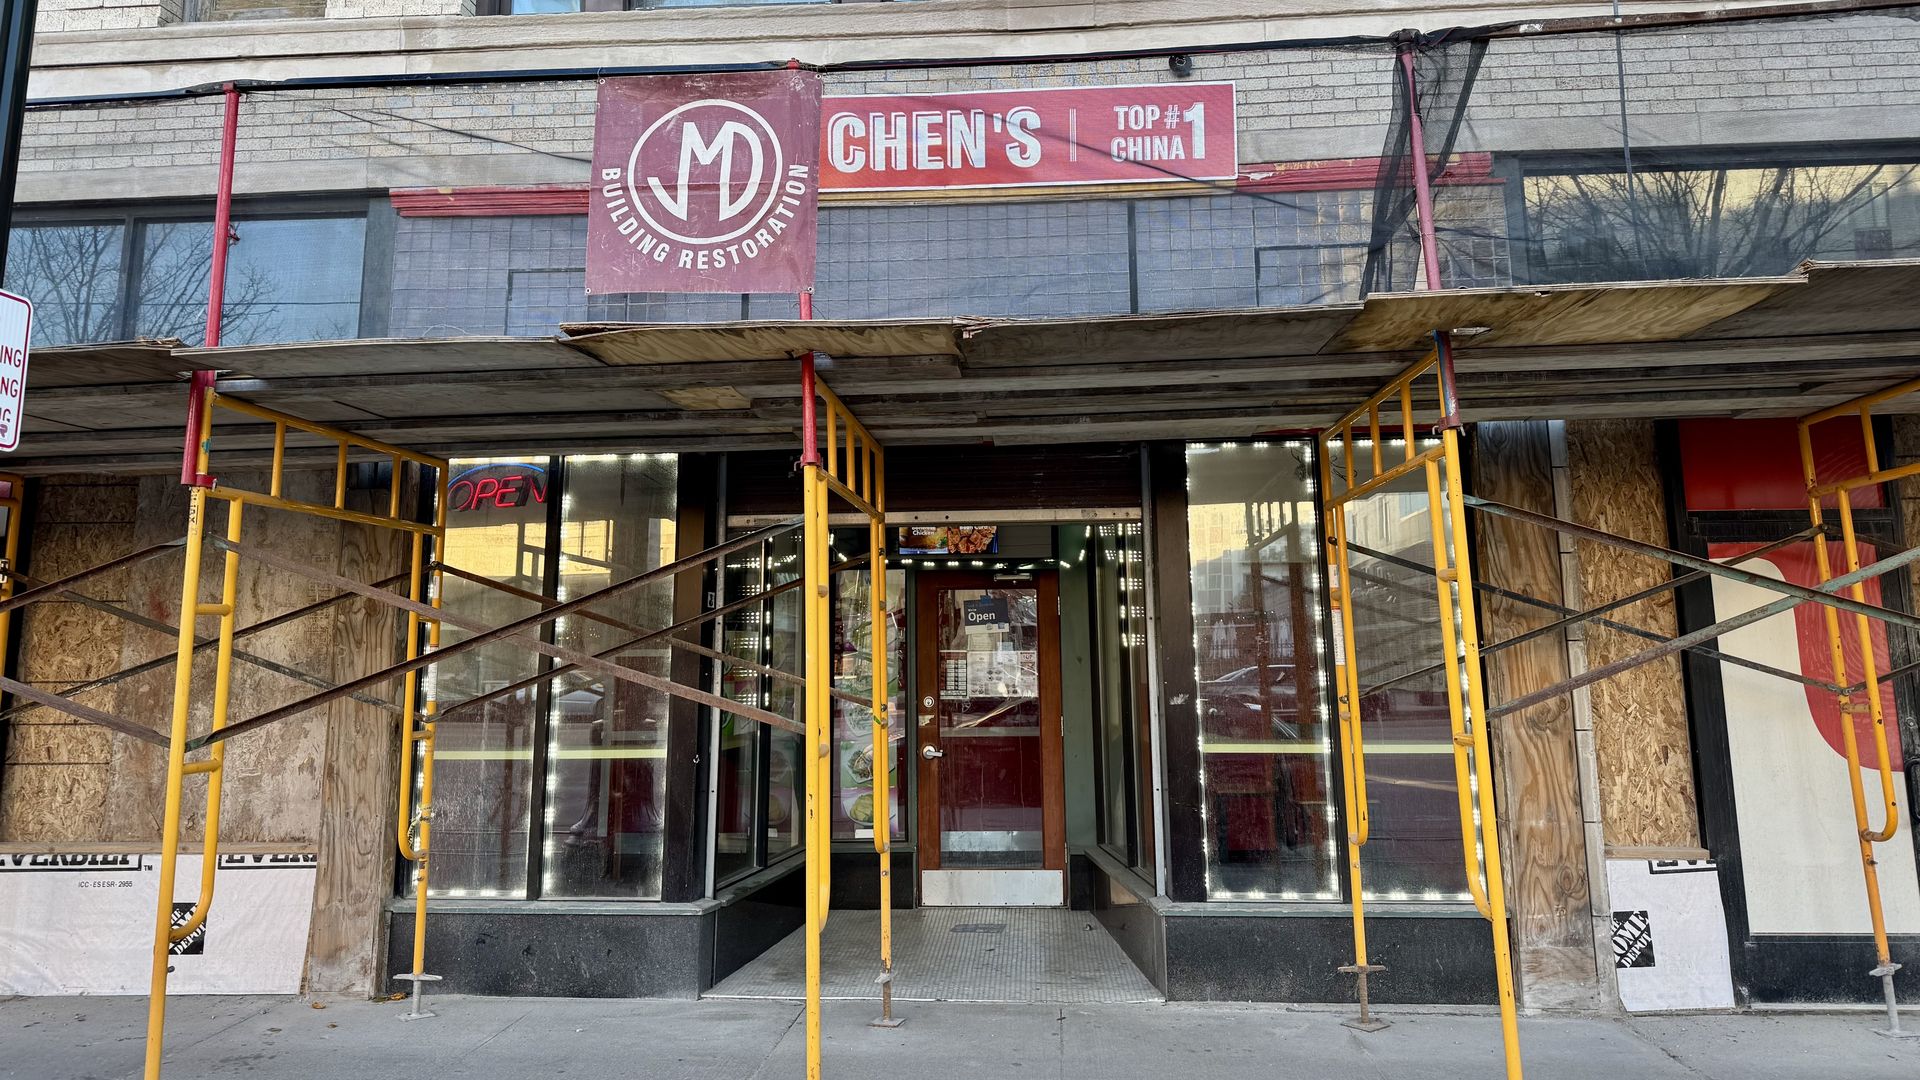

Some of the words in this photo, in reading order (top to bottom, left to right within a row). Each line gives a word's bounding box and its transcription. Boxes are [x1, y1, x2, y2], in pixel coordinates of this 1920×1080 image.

[1114, 105, 1160, 131] TOP
[827, 106, 1041, 173] CHEN'S
[1111, 135, 1186, 162] CHINA
[601, 167, 670, 263] BUILDING
[678, 164, 809, 270] RESTORATION
[448, 474, 548, 511] OPEN
[968, 611, 996, 623] Open
[171, 908, 184, 925] HE
[1612, 910, 1650, 963] OME
